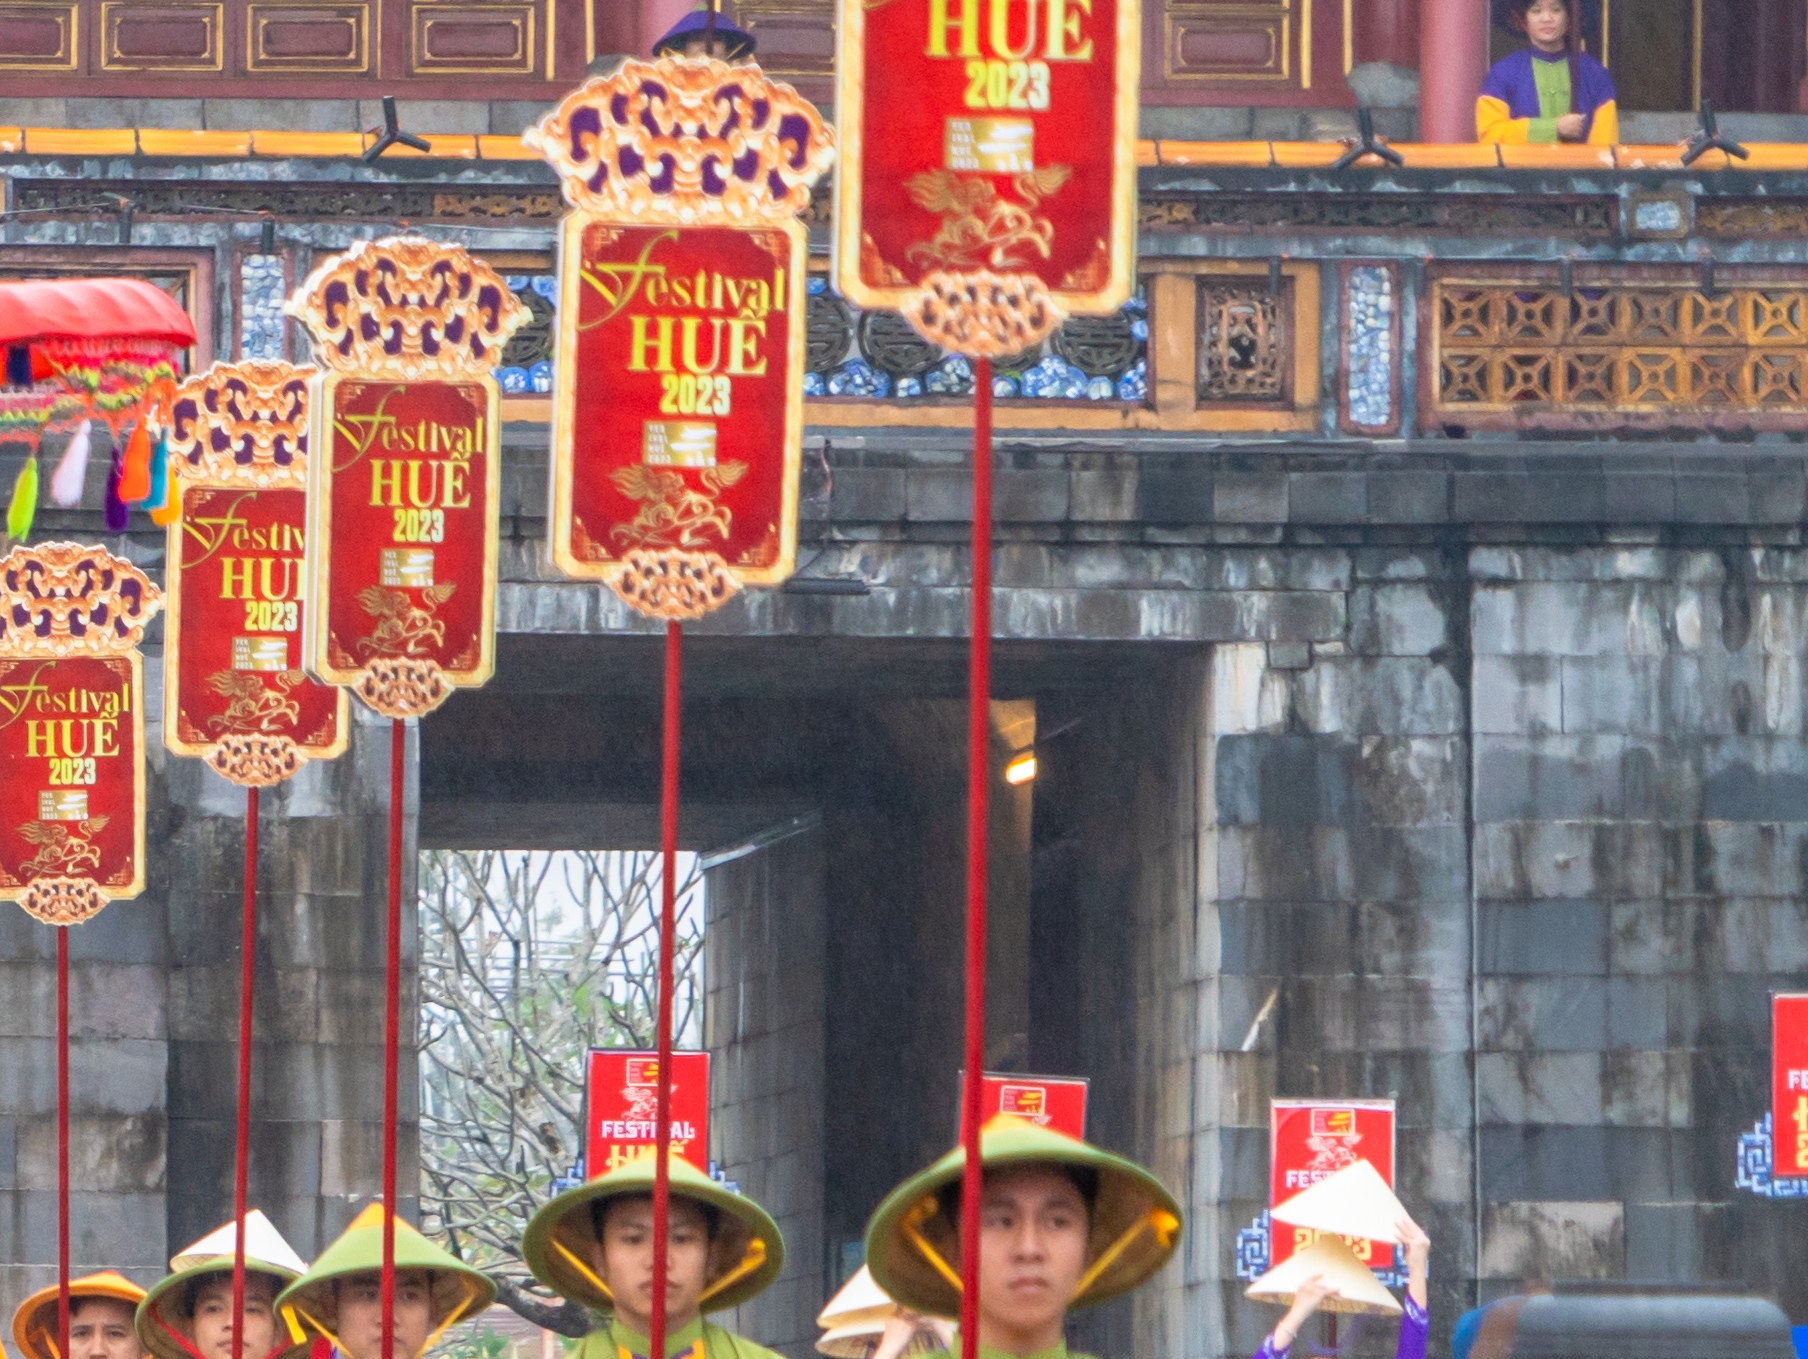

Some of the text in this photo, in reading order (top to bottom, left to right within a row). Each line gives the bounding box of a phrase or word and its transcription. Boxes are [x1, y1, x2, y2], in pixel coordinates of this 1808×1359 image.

[965, 61, 1050, 109] 2023
[577, 230, 784, 331] Festival
[628, 308, 768, 376] HUẾ
[661, 374, 731, 415] 2023
[332, 385, 483, 474] Festival
[369, 450, 471, 508] HUẾ
[393, 509, 444, 542] 2023
[245, 602, 297, 632] 2023
[25, 711, 120, 758] HUẾ
[49, 757, 96, 785] 2023
[601, 1120, 696, 1139] FESTIAL
